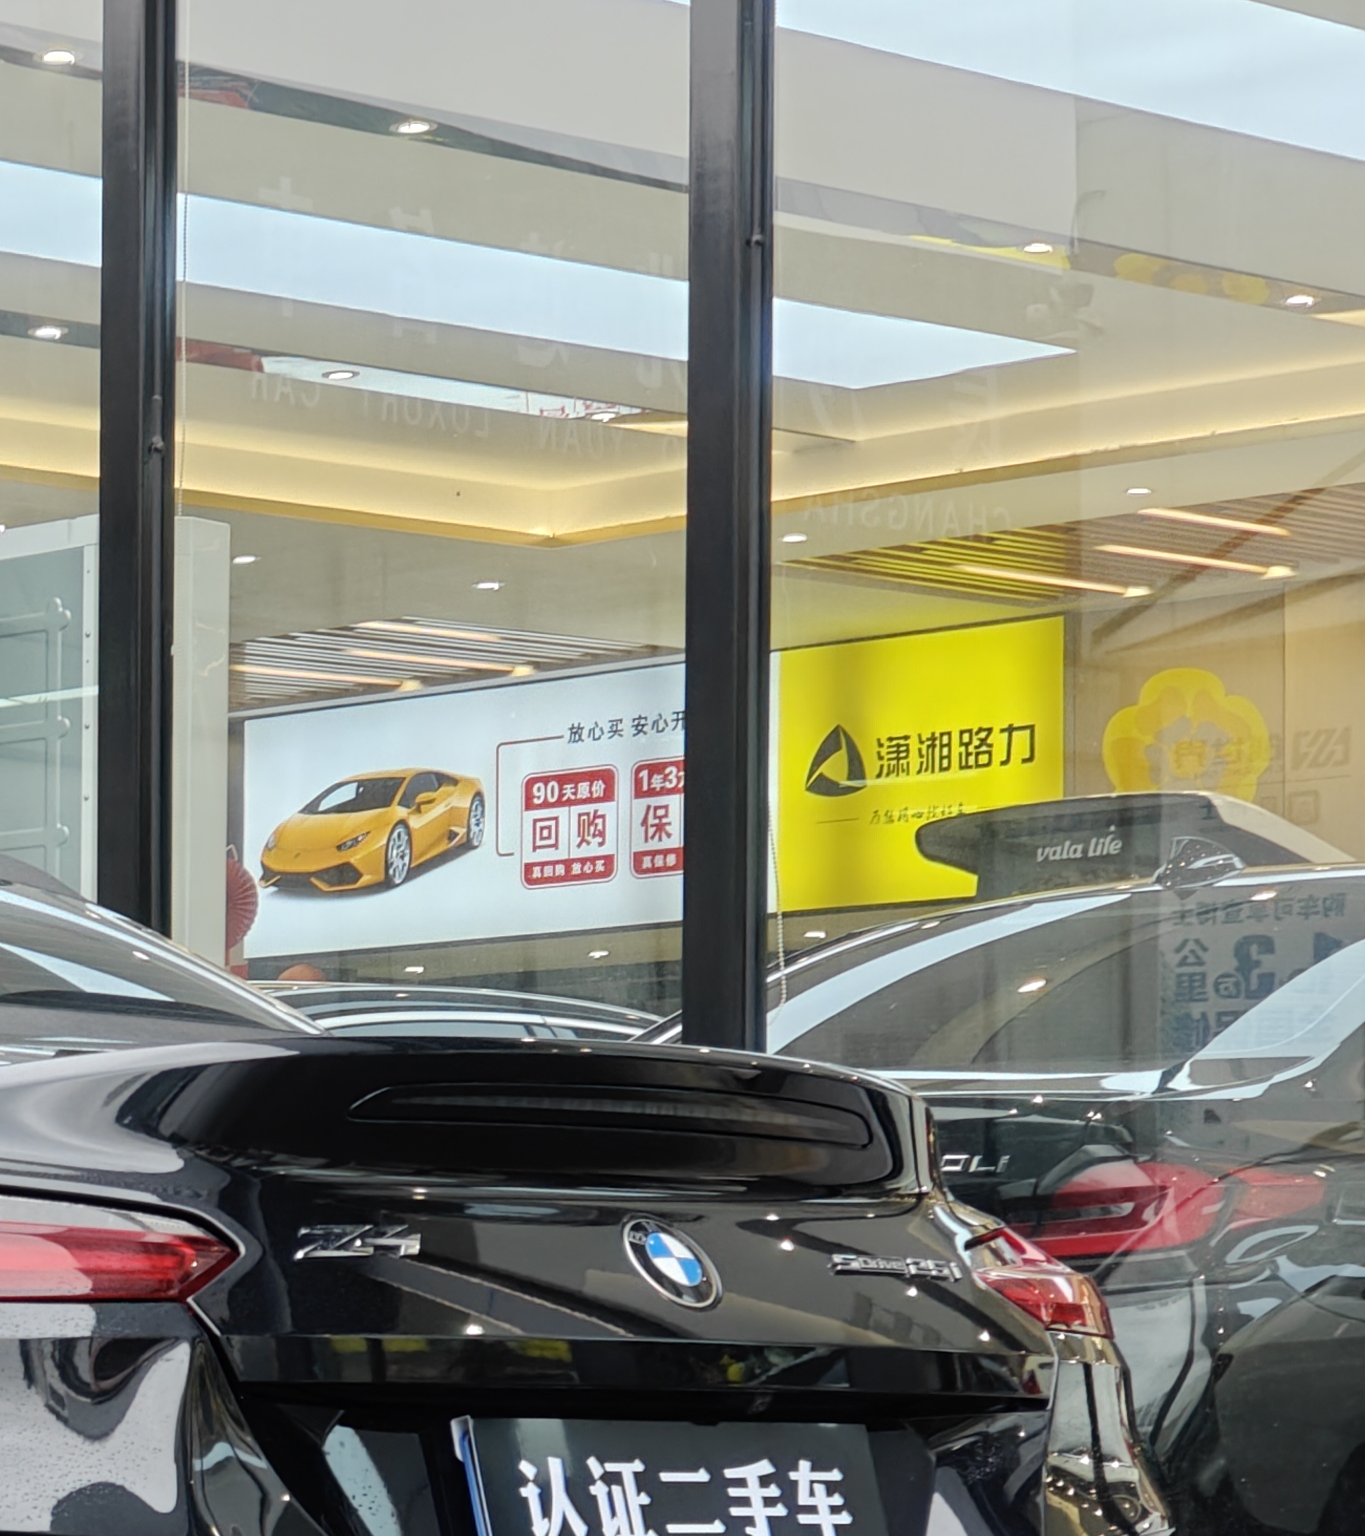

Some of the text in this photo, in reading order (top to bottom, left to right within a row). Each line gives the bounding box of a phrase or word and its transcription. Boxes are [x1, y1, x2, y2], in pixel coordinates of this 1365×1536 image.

[566, 710, 686, 744] 放心买 安心开
[874, 722, 1037, 781] 潇湘路力
[531, 808, 607, 854] 回购
[1036, 832, 1123, 863] vala life
[293, 1223, 422, 1262] Z4
